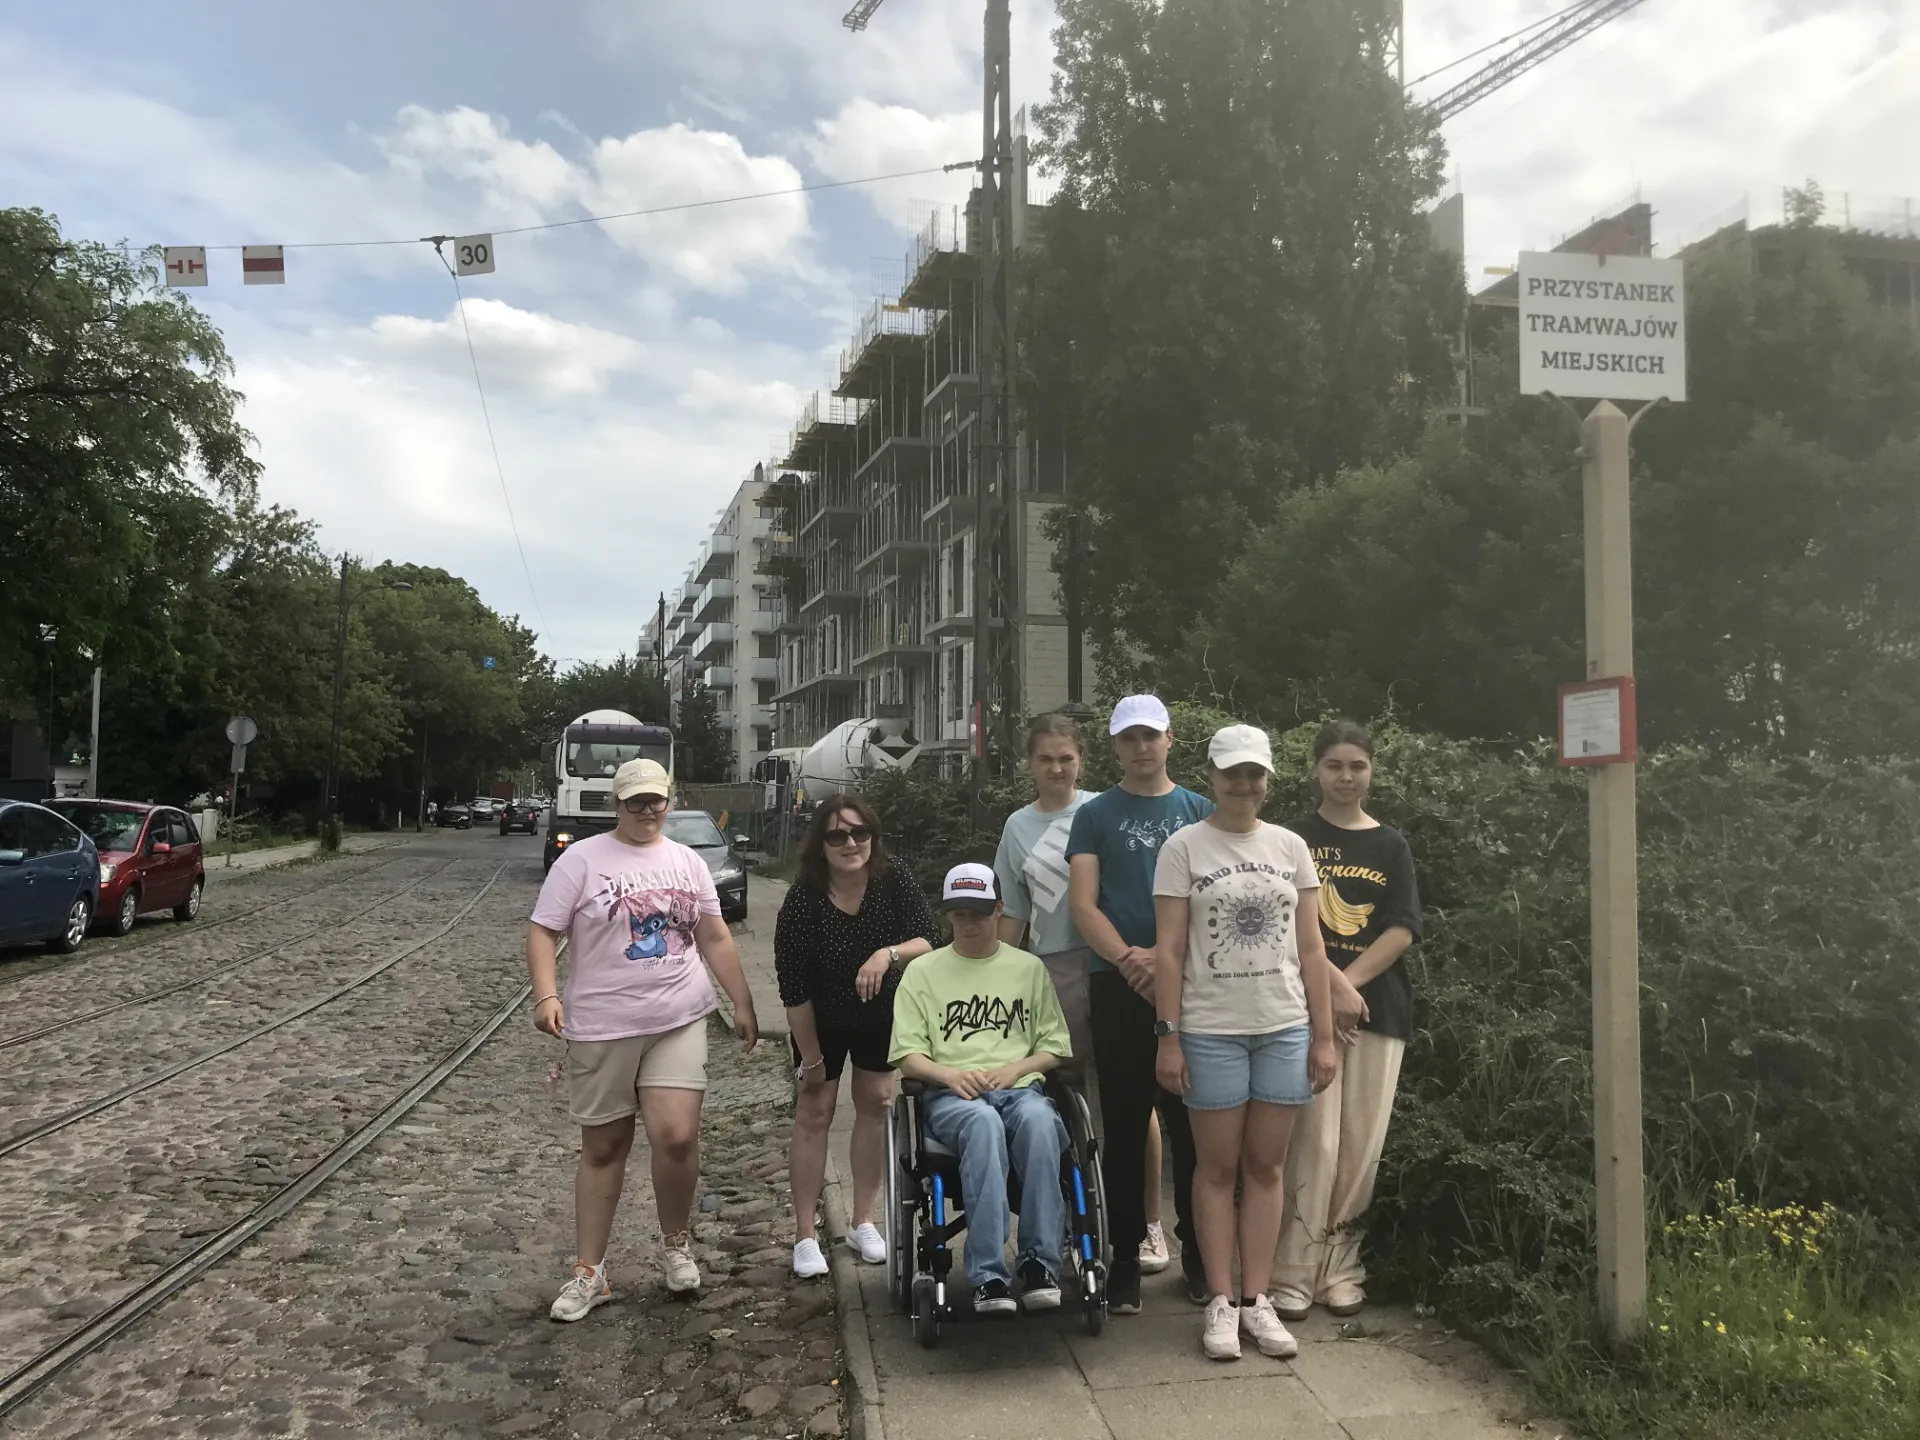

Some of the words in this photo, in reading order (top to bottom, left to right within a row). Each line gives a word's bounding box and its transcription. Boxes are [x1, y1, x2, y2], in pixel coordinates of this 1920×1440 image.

[460, 243, 488, 266] 30
[1527, 277, 1675, 303] PRZYSTANEK
[1526, 313, 1678, 339] TRAMWAJÓW
[1541, 350, 1665, 374] MIEJSKICH
[1309, 846, 1341, 860] HAT'S
[608, 868, 700, 900] PARADIS
[943, 994, 1026, 1042] BROOKLYN
